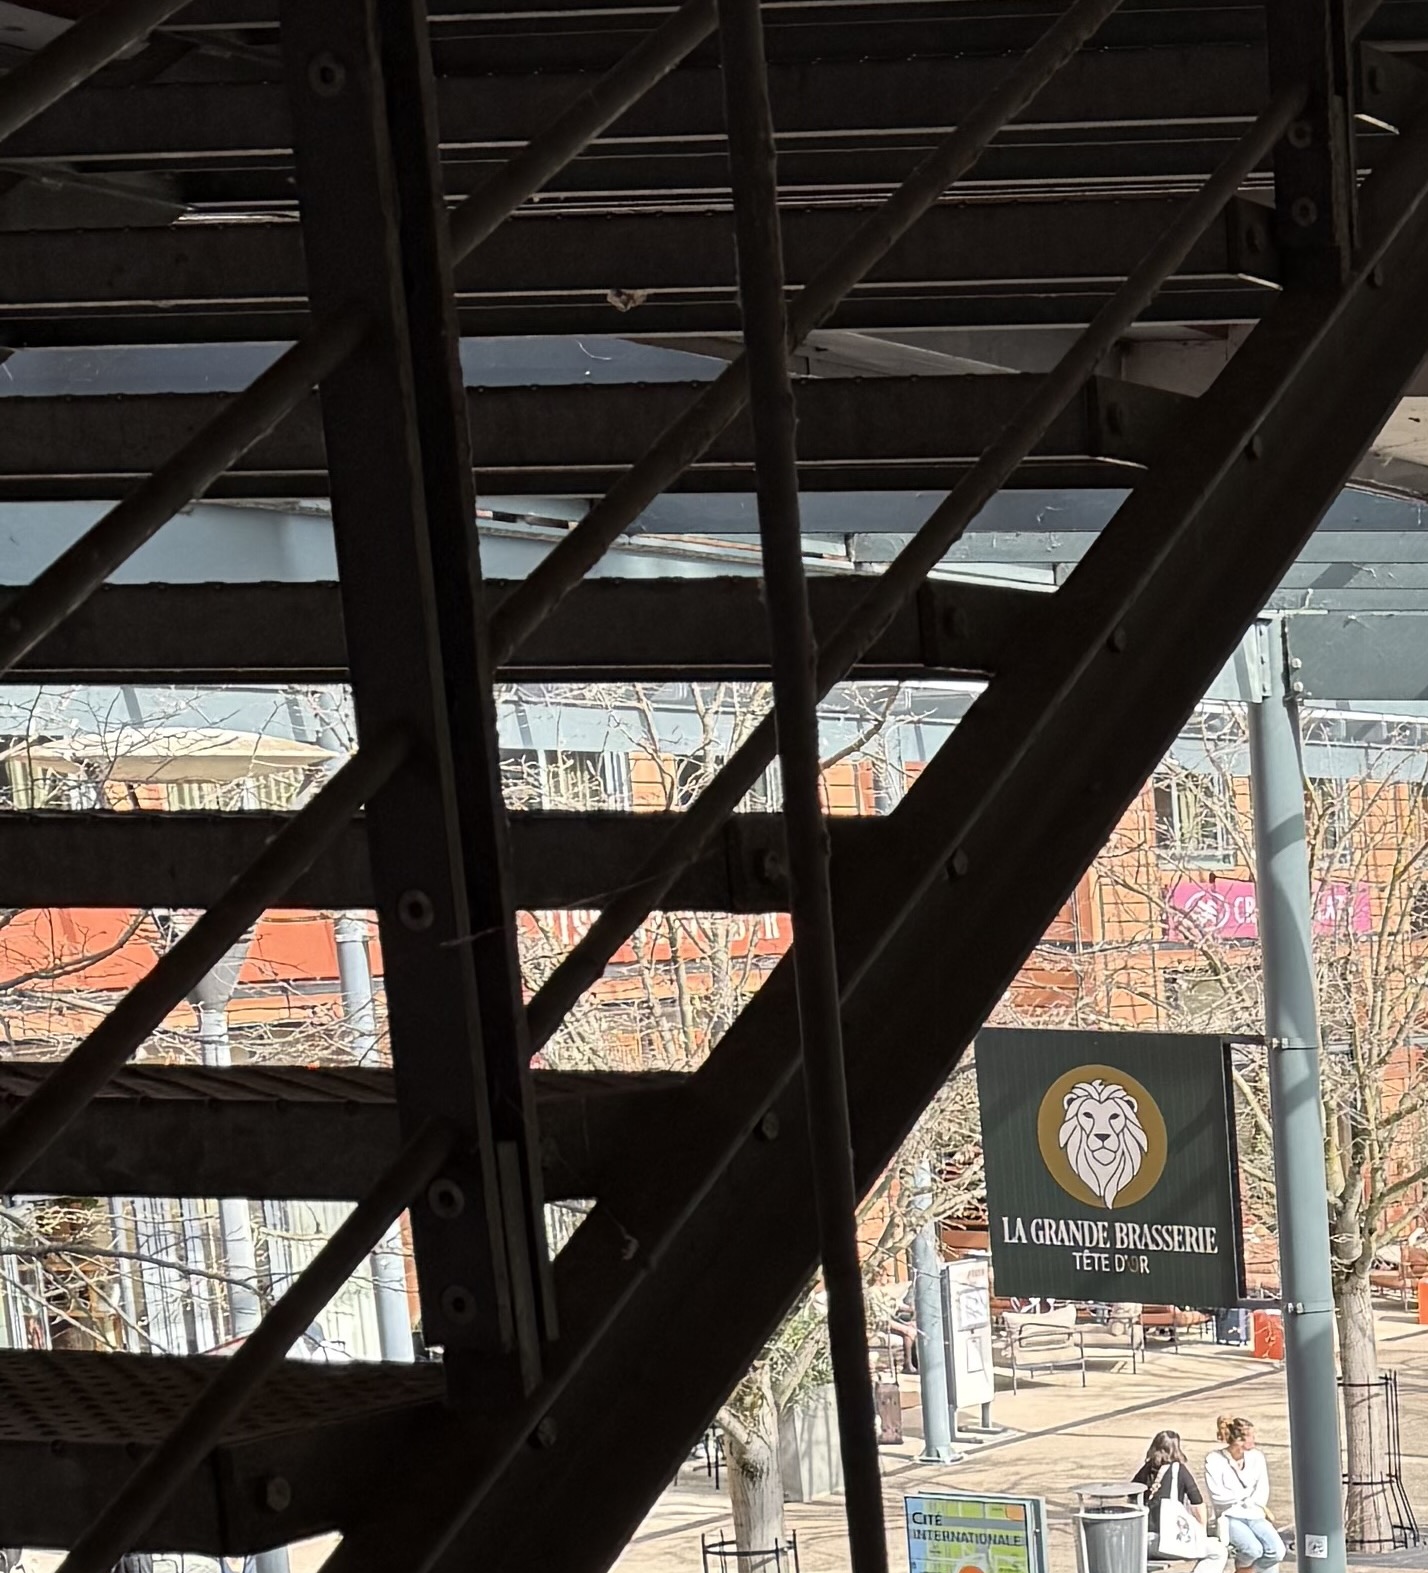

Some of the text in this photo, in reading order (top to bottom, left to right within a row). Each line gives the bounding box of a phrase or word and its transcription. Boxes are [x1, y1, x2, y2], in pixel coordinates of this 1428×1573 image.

[1001, 1216, 1218, 1254] LA GRANDE BRASSERIE
[1072, 1250, 1150, 1274] TÊTE D'OR
[913, 1529, 1026, 1546] INTERNATIONALE
